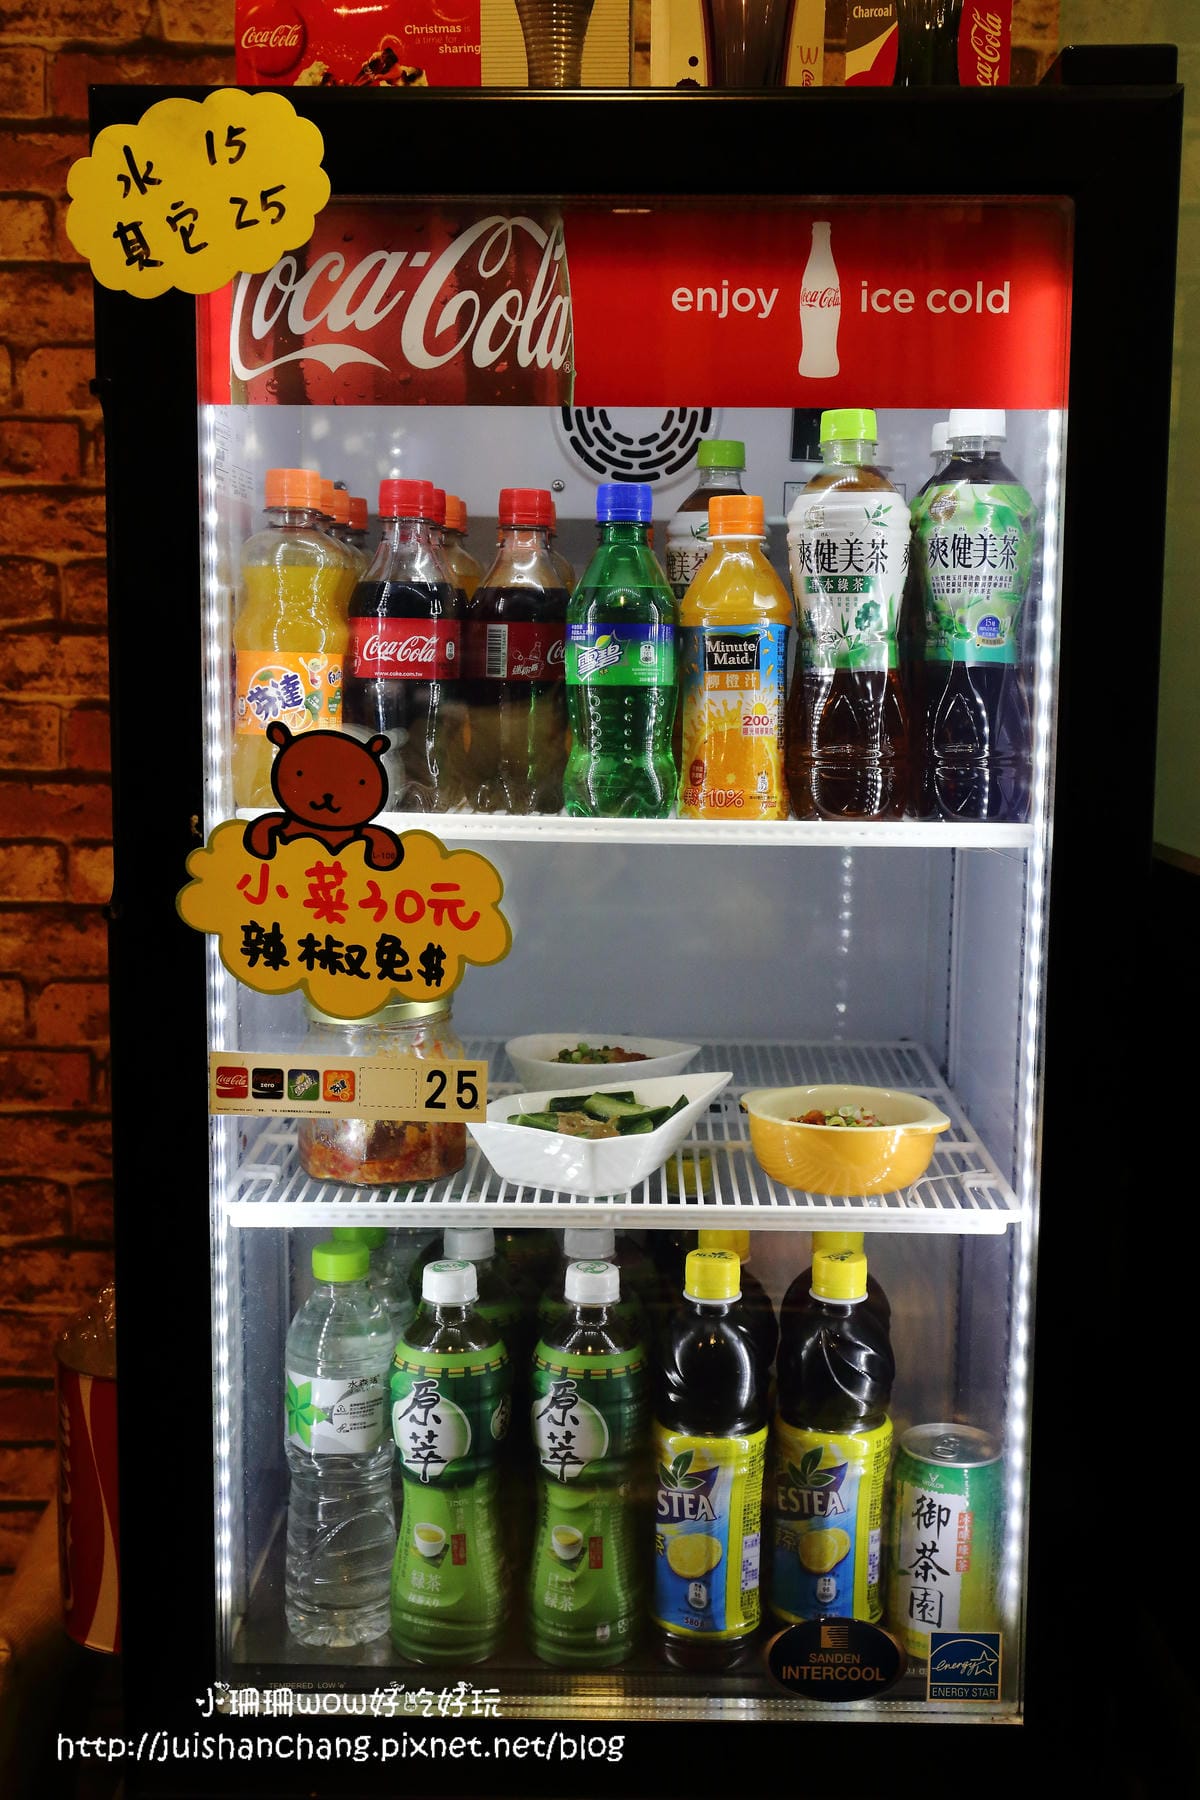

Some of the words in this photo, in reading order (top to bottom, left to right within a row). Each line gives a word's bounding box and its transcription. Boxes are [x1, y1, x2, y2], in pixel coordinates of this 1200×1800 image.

[852, 6, 893, 18] Charcoal
[241, 24, 302, 49] Coca-Cola
[404, 24, 462, 35] Christmas
[438, 43, 481, 55] sharing
[116, 145, 163, 199] 水
[205, 124, 247, 166] 15
[229, 184, 287, 230] 25
[671, 279, 779, 319] enjoy
[860, 280, 915, 314] ice
[926, 281, 1010, 314] cold
[797, 537, 888, 574] 爽健美茶
[928, 532, 1019, 571] 爽健美茶
[362, 634, 440, 662] Coca-Cola
[707, 641, 756, 653] Minute
[713, 653, 748, 665] Maid
[424, 1069, 479, 1110] 25
[656, 1490, 717, 1521] STEA
[777, 1486, 846, 1516] ESTEA
[908, 1494, 951, 1628] 御茶園
[808, 1652, 861, 1664] SANDEN
[932, 1659, 982, 1676] energy
[317, 1681, 336, 1689] LOW
[782, 1666, 886, 1681] INTERCOOL
[932, 1687, 970, 1697] ENERGY
[971, 1687, 996, 1697] STAR
